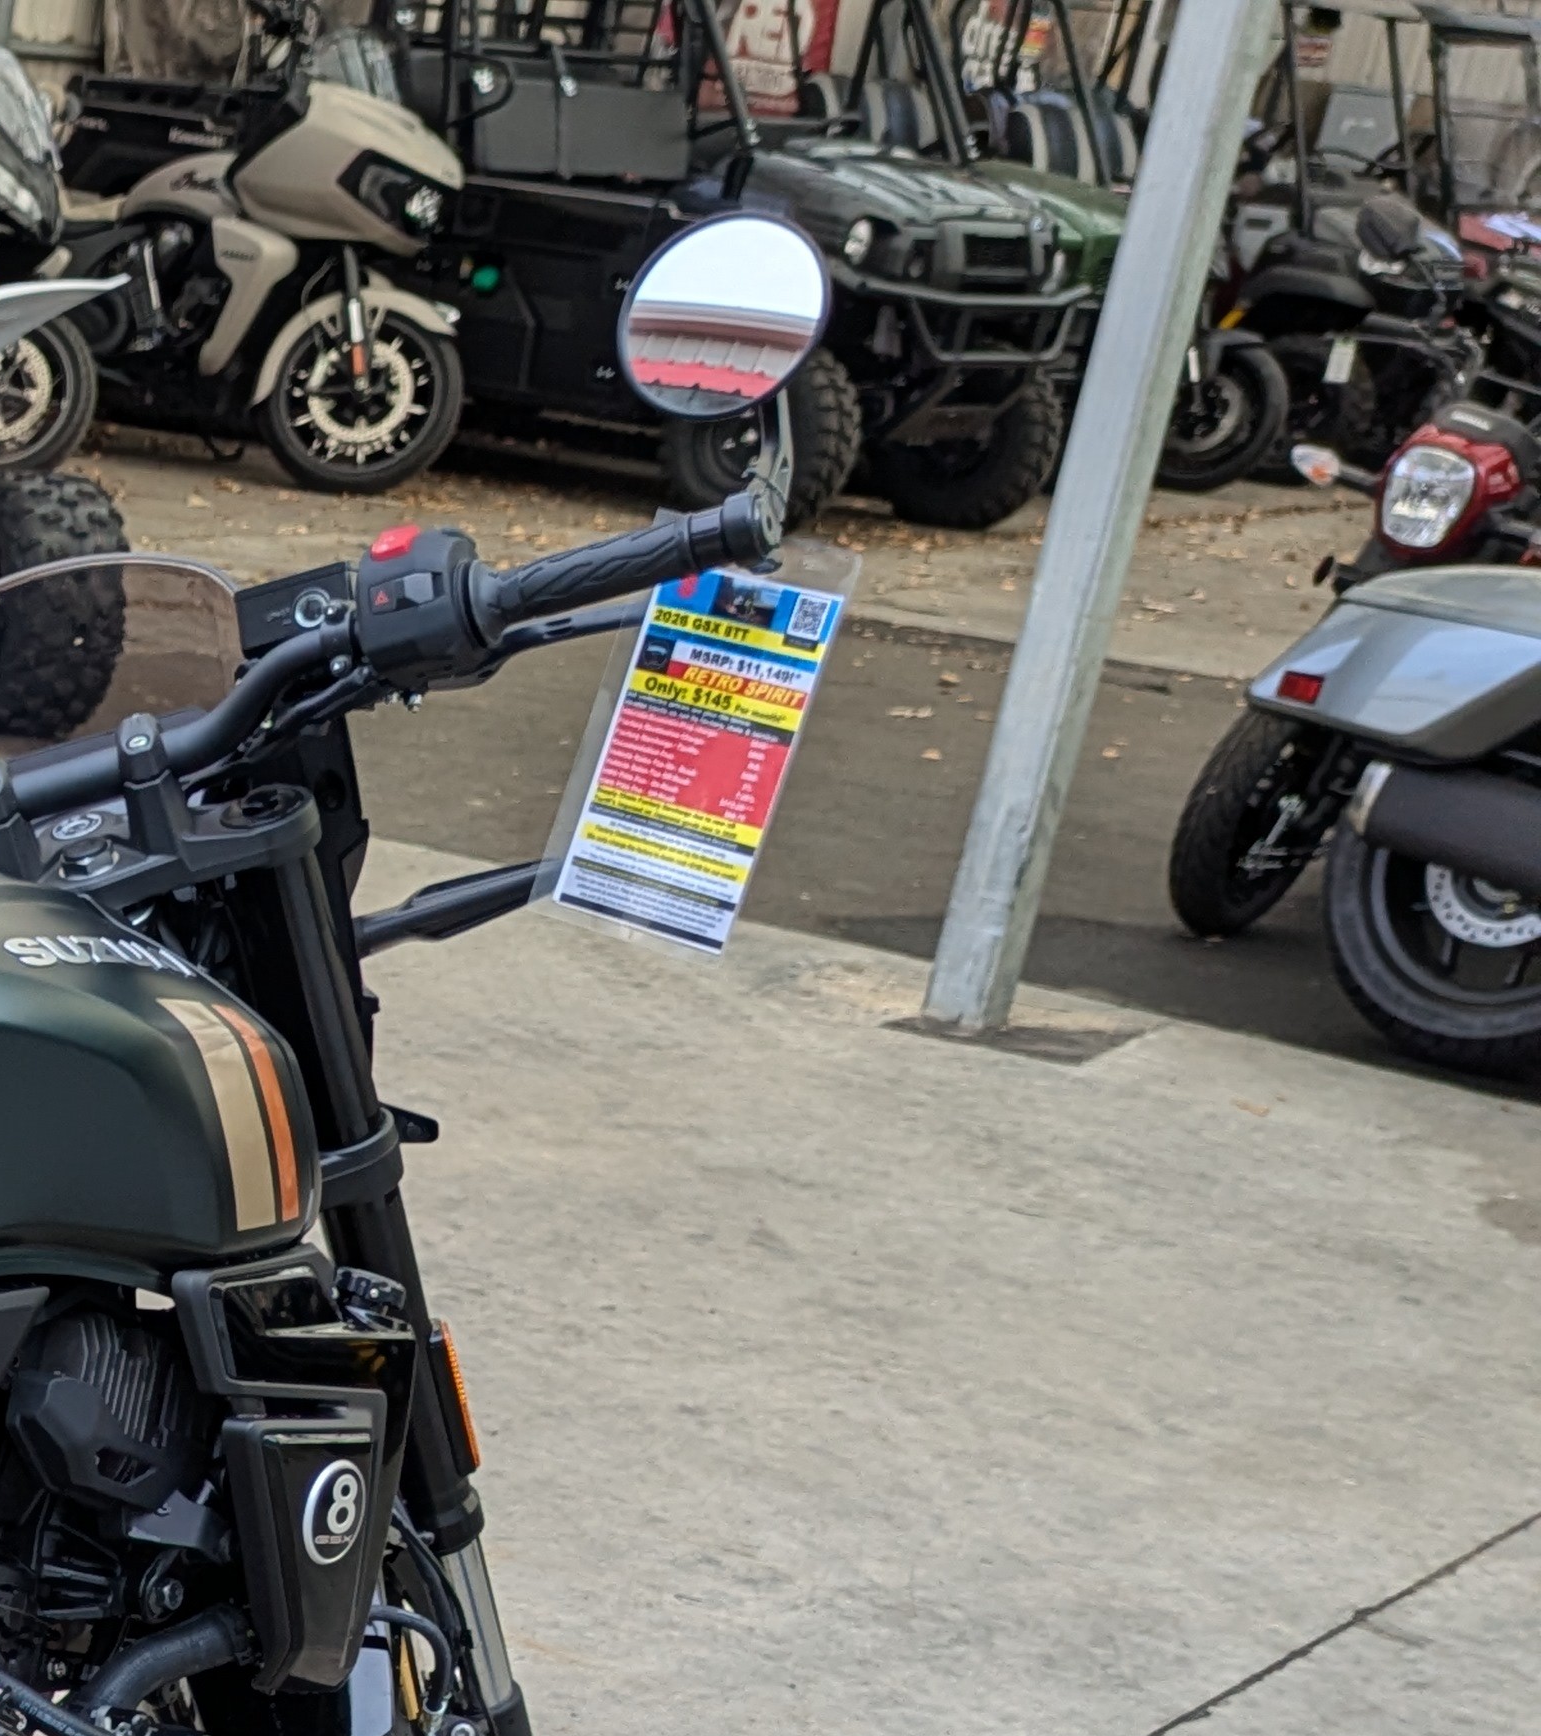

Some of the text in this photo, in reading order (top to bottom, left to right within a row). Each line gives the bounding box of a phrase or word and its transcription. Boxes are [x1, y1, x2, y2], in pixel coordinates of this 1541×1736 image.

[682, 665, 805, 707] RETRO SPIRIT
[327, 1473, 359, 1535] 8
